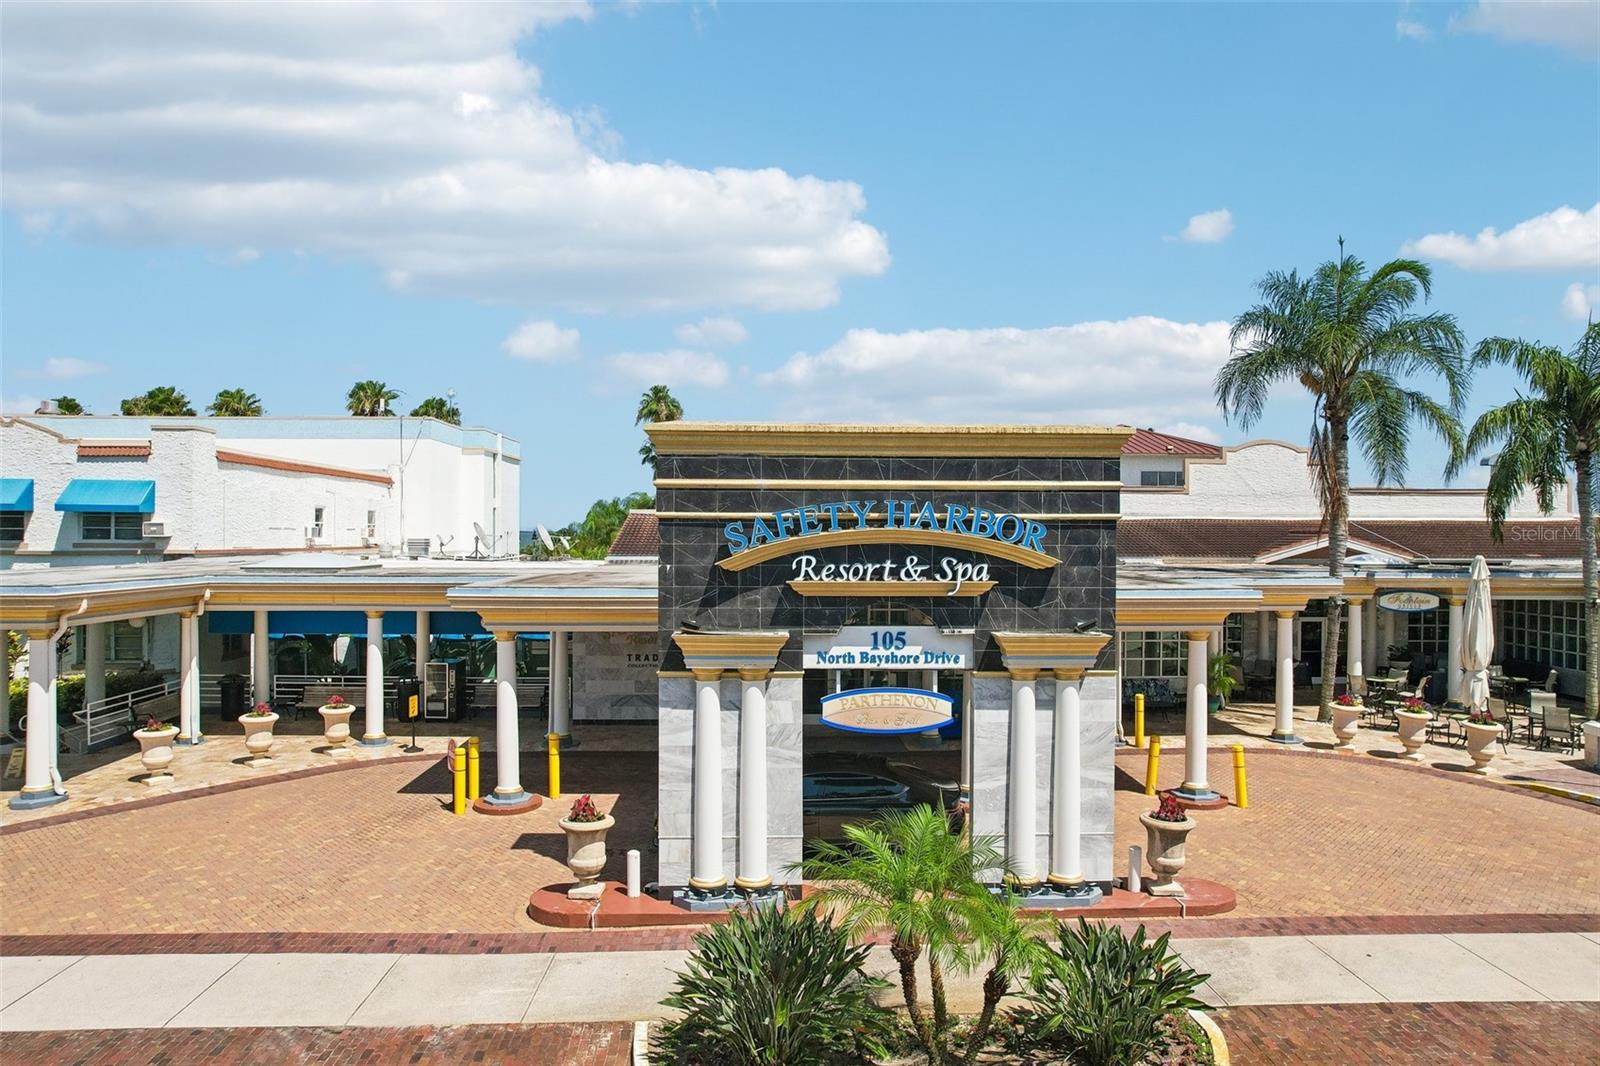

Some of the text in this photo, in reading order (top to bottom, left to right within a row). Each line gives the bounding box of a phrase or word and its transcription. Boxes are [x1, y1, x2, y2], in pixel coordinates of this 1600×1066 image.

[723, 499, 1048, 555] SAFETY HARBOR
[791, 555, 990, 596] Resort & Spa
[870, 631, 907, 651] 105
[816, 651, 961, 667] North Bayshore Drive
[840, 694, 938, 711] PARTHENON
